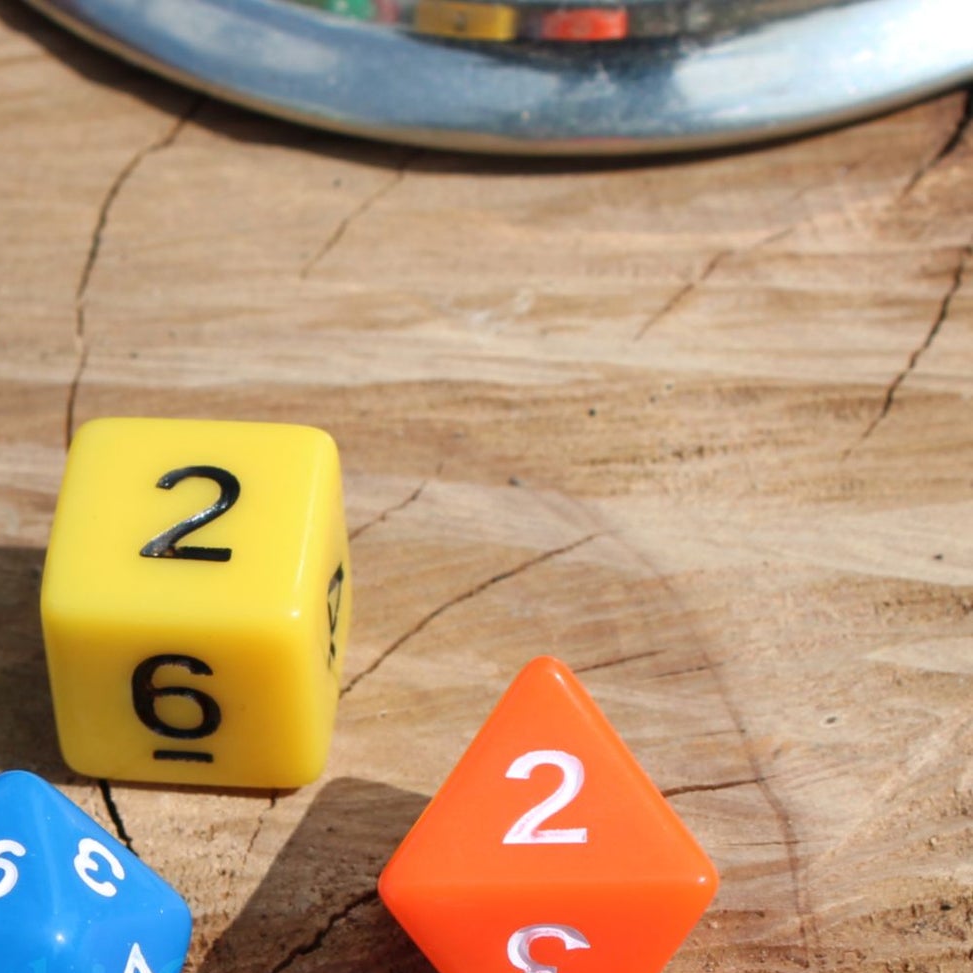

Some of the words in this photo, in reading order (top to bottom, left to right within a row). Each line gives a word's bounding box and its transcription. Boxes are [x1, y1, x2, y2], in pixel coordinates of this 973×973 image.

[139, 464, 241, 562] 2
[130, 653, 222, 764] 6
[502, 749, 588, 846] 2
[74, 838, 126, 898] 3
